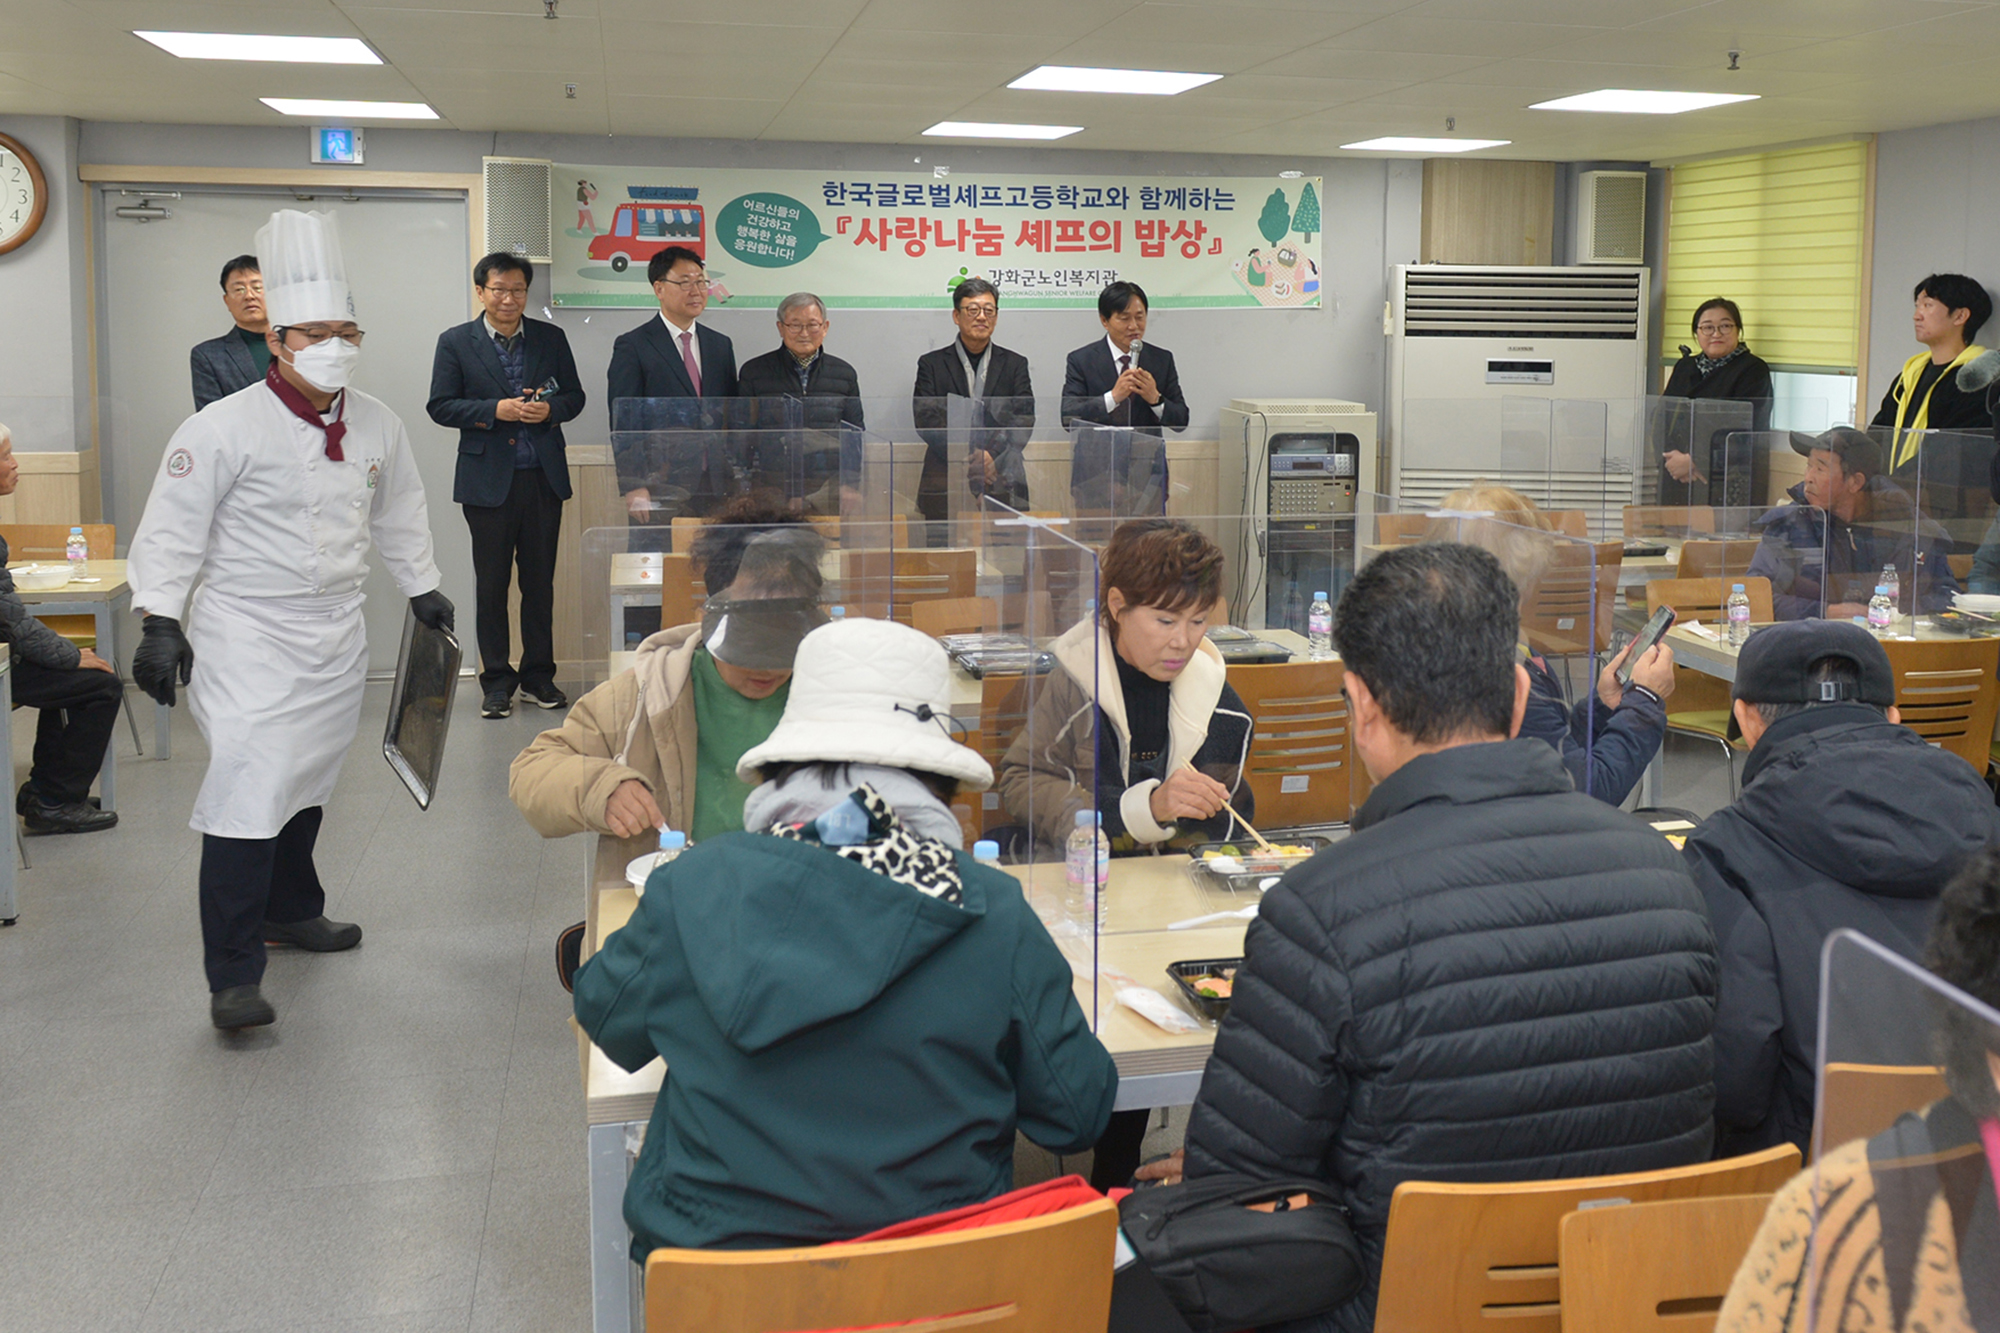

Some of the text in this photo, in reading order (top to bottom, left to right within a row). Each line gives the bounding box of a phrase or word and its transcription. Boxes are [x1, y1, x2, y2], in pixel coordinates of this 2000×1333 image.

[11, 167, 20, 182] 2
[18, 189, 28, 204] 3
[822, 182, 1235, 211] 한국글로벌셰프고등학교와 함께하는
[9, 209, 20, 223] 4
[743, 199, 800, 221] 어르신들의
[747, 213, 792, 232] 건강하고
[736, 224, 798, 248] 행복한 삶을
[1014, 219, 1121, 253] 셰프의
[734, 238, 795, 261] 응원합니다!
[989, 269, 1118, 287] 강화군노인복지관
